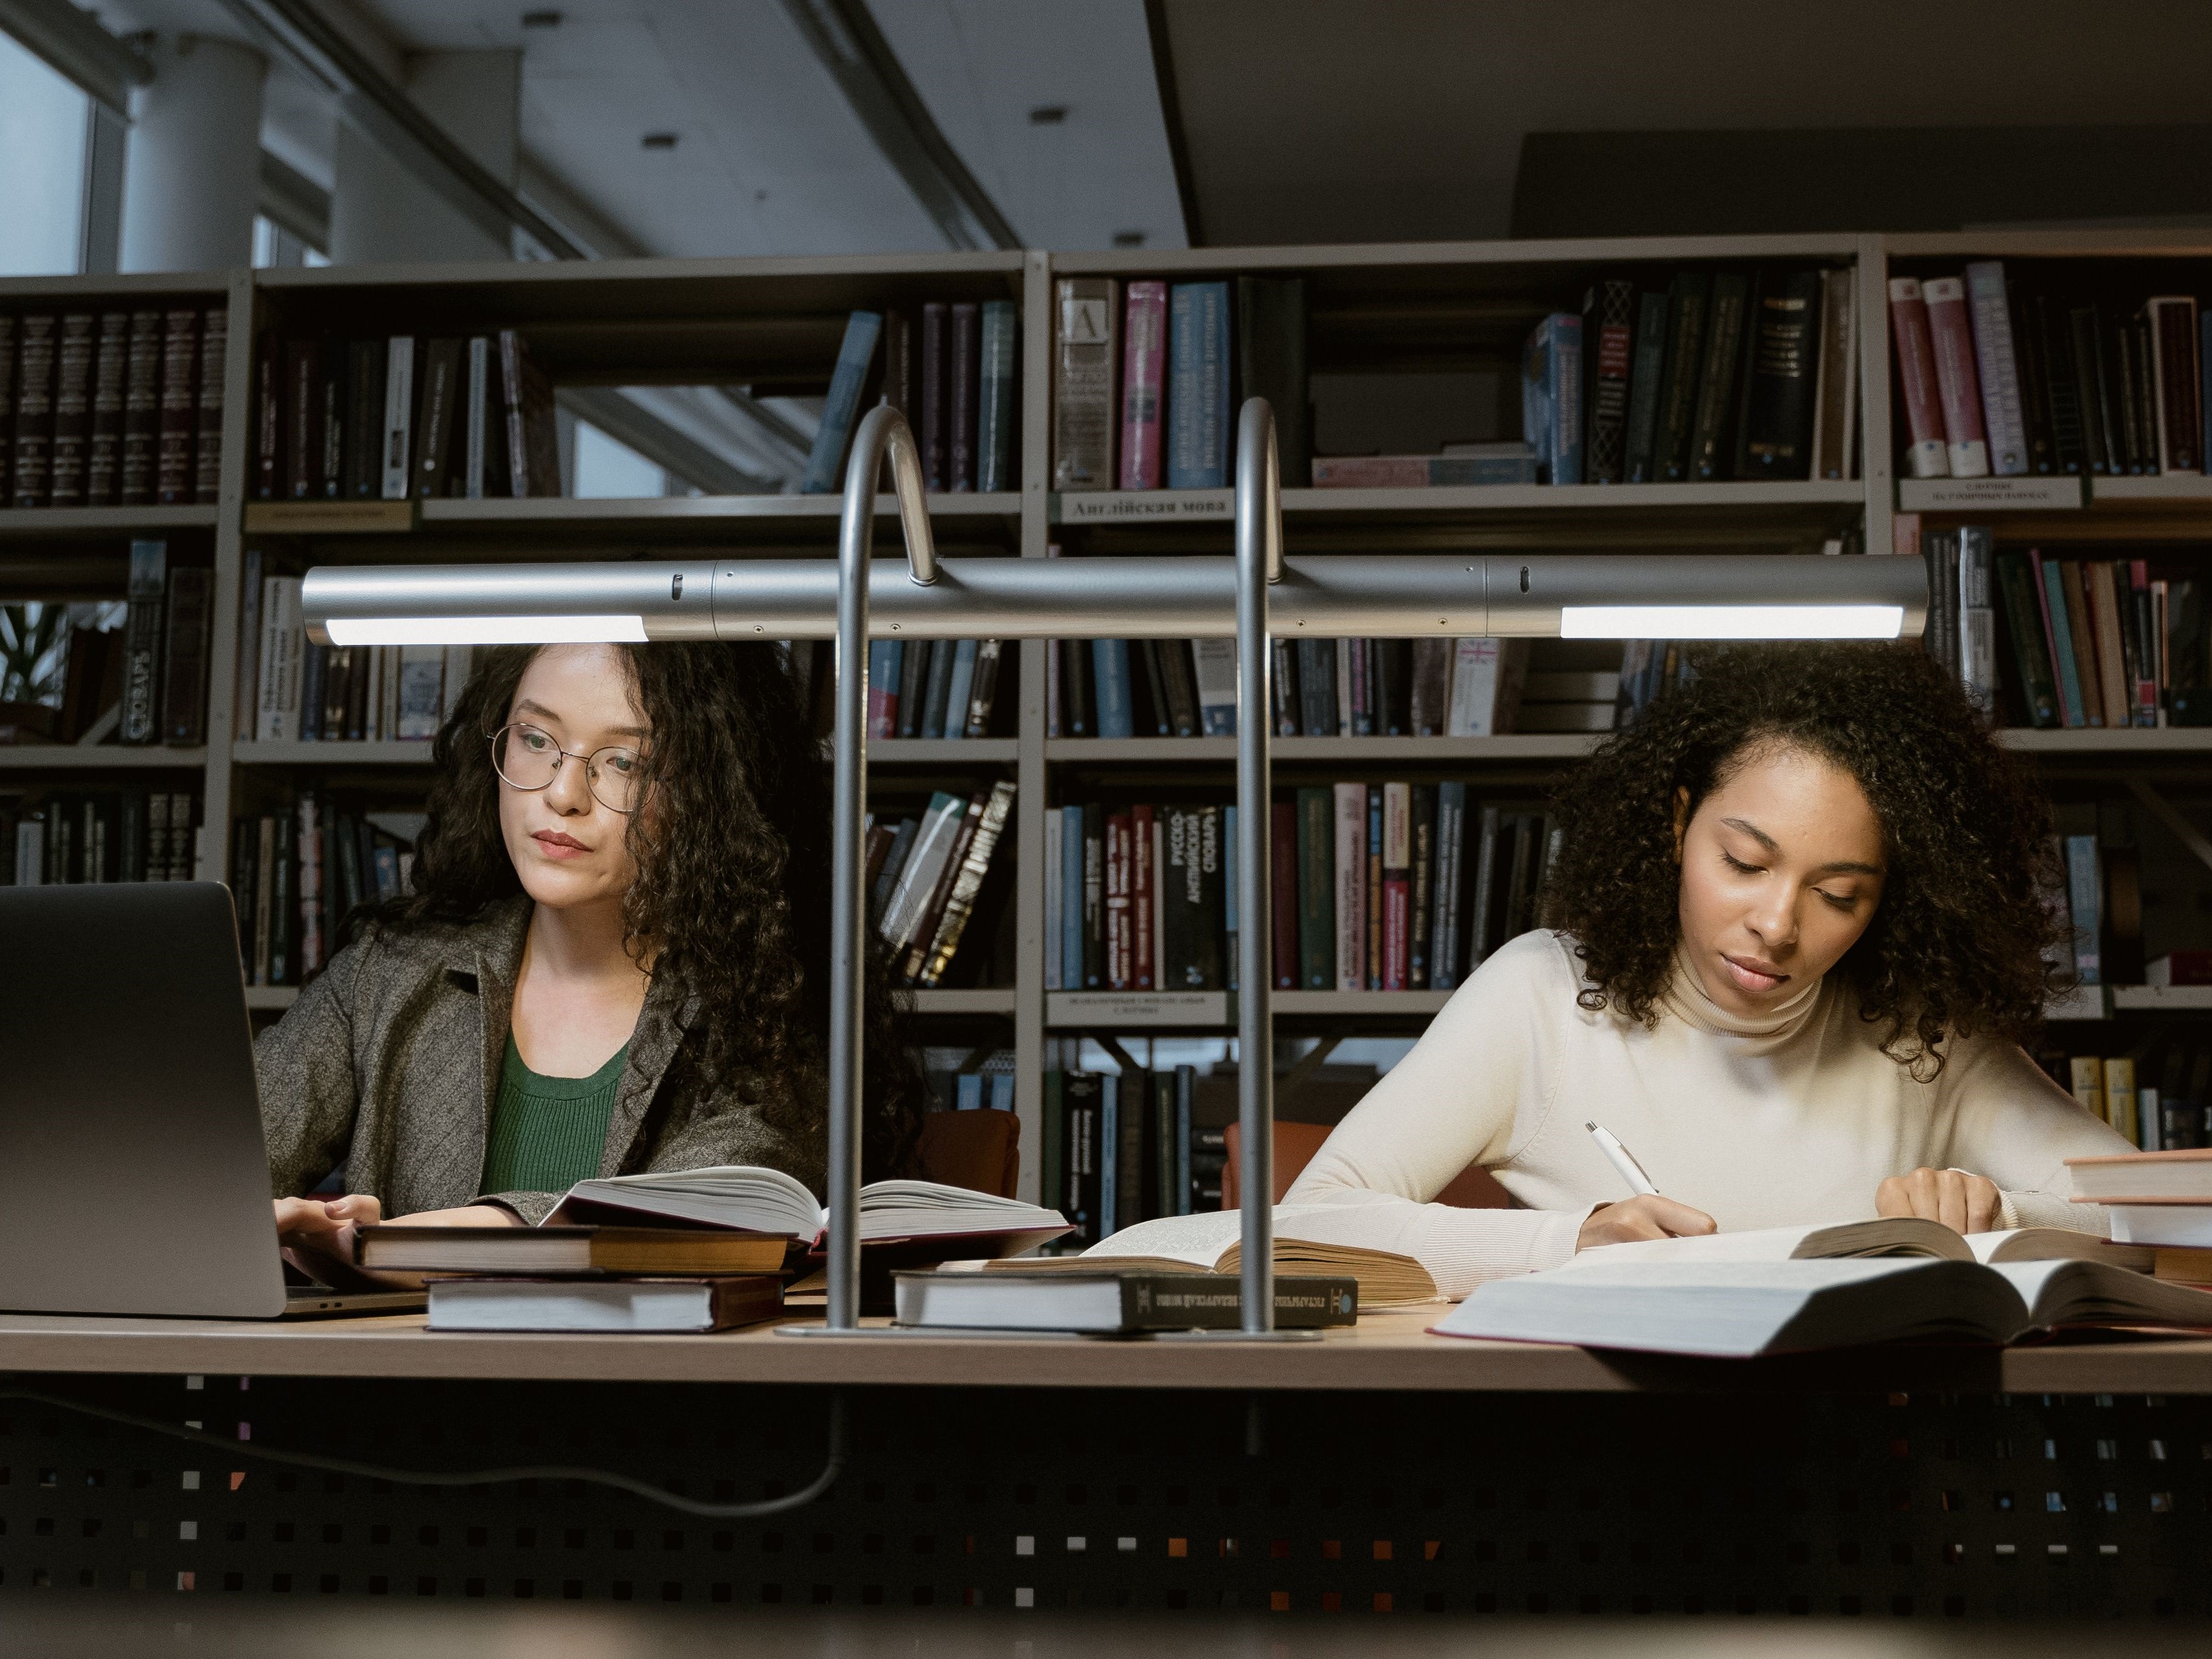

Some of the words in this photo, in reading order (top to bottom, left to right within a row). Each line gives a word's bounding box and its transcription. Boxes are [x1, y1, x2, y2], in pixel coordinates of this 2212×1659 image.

[1073, 498, 1176, 517] Англійская
[1182, 500, 1226, 513] мова
[1156, 1294, 1183, 1306] МОВЫ
[1183, 1294, 1238, 1309] БЕЛАРУСКАЙ
